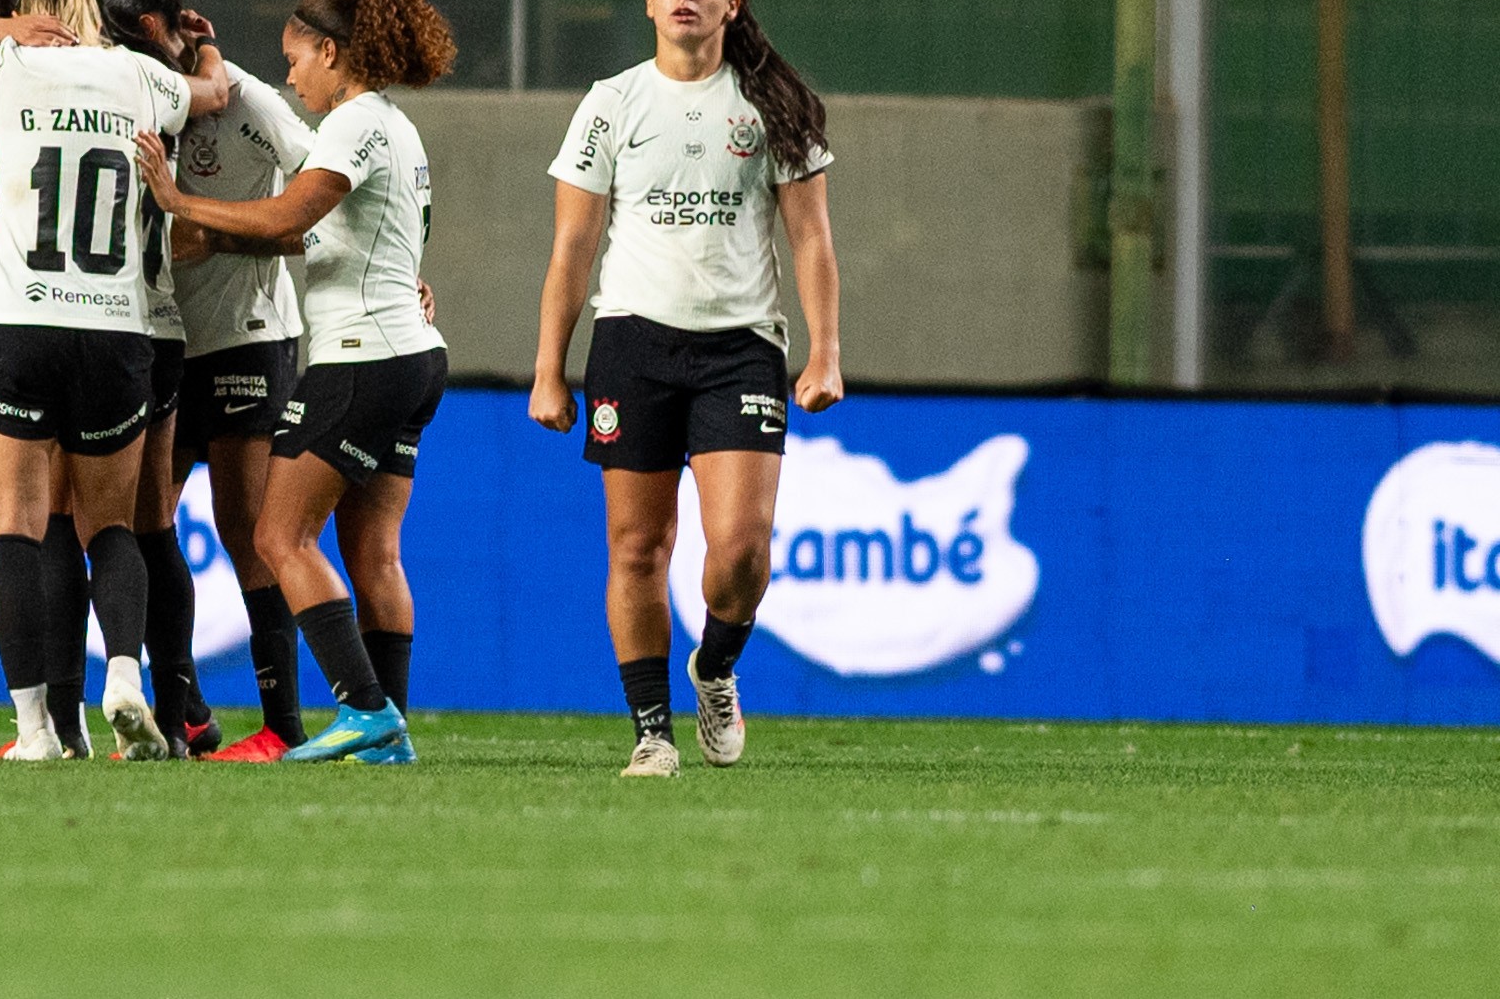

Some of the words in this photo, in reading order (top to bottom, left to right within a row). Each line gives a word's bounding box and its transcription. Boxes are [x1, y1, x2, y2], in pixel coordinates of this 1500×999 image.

[20, 108, 42, 132] G.
[354, 128, 389, 163] bmg
[578, 115, 611, 160] bmg
[25, 144, 131, 276] 10
[646, 188, 744, 210] Esportes
[51, 286, 131, 307] Remessa
[103, 307, 131, 318] Online
[214, 373, 268, 388] RESPEITA
[230, 386, 268, 398] MINAS
[80, 412, 139, 442] tecnogera
